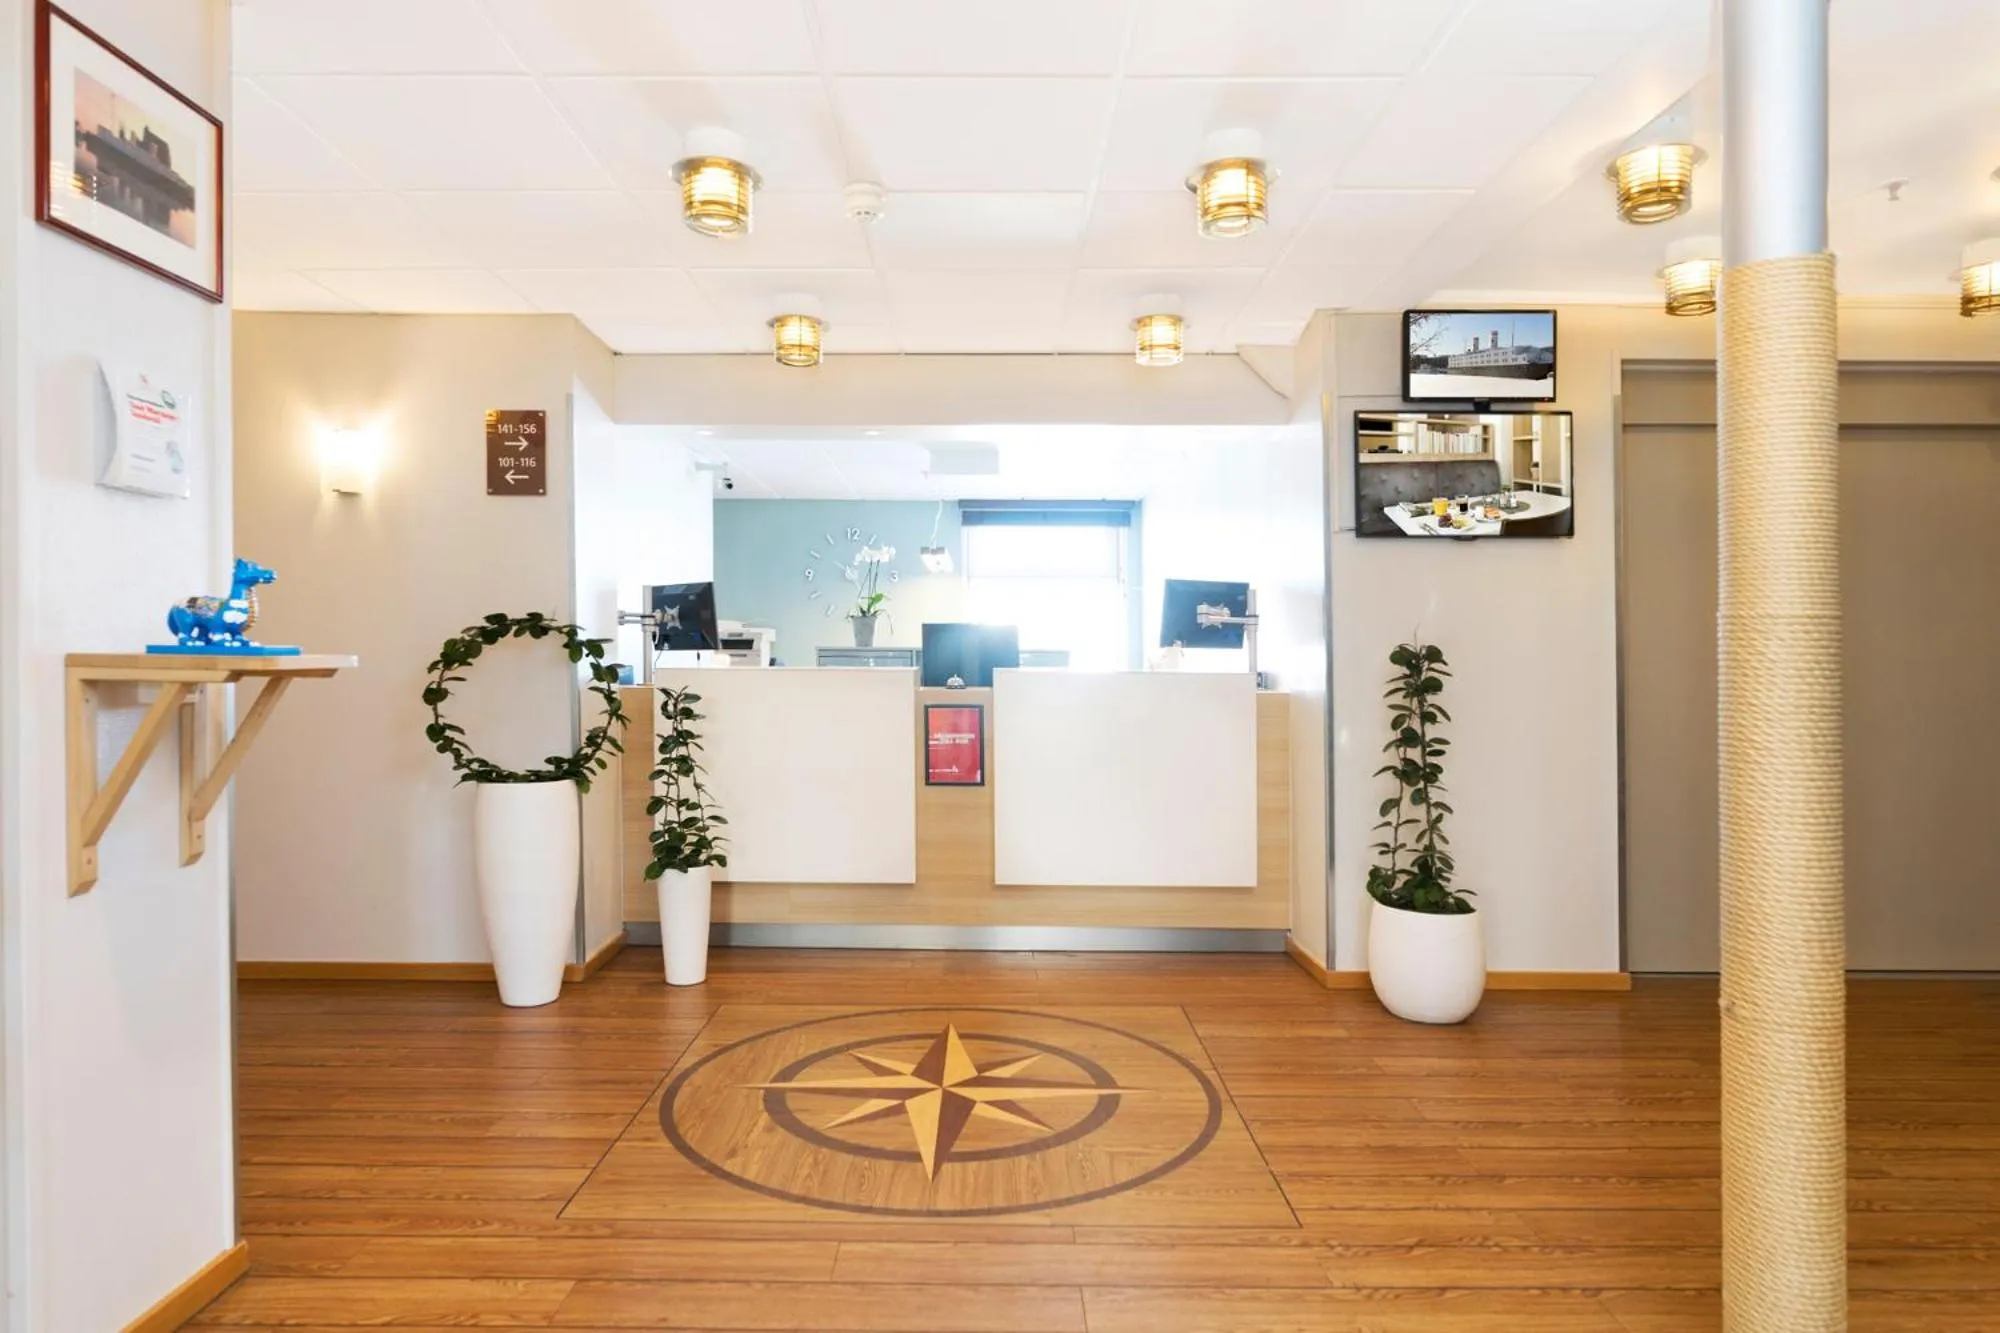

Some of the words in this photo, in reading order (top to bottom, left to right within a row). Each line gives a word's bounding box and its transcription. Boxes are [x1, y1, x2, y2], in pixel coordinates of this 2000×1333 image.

[498, 423, 537, 434] 141-156
[498, 456, 536, 467] 101-116
[847, 527, 861, 541] 12
[805, 568, 814, 581] 9
[889, 570, 899, 583] 3
